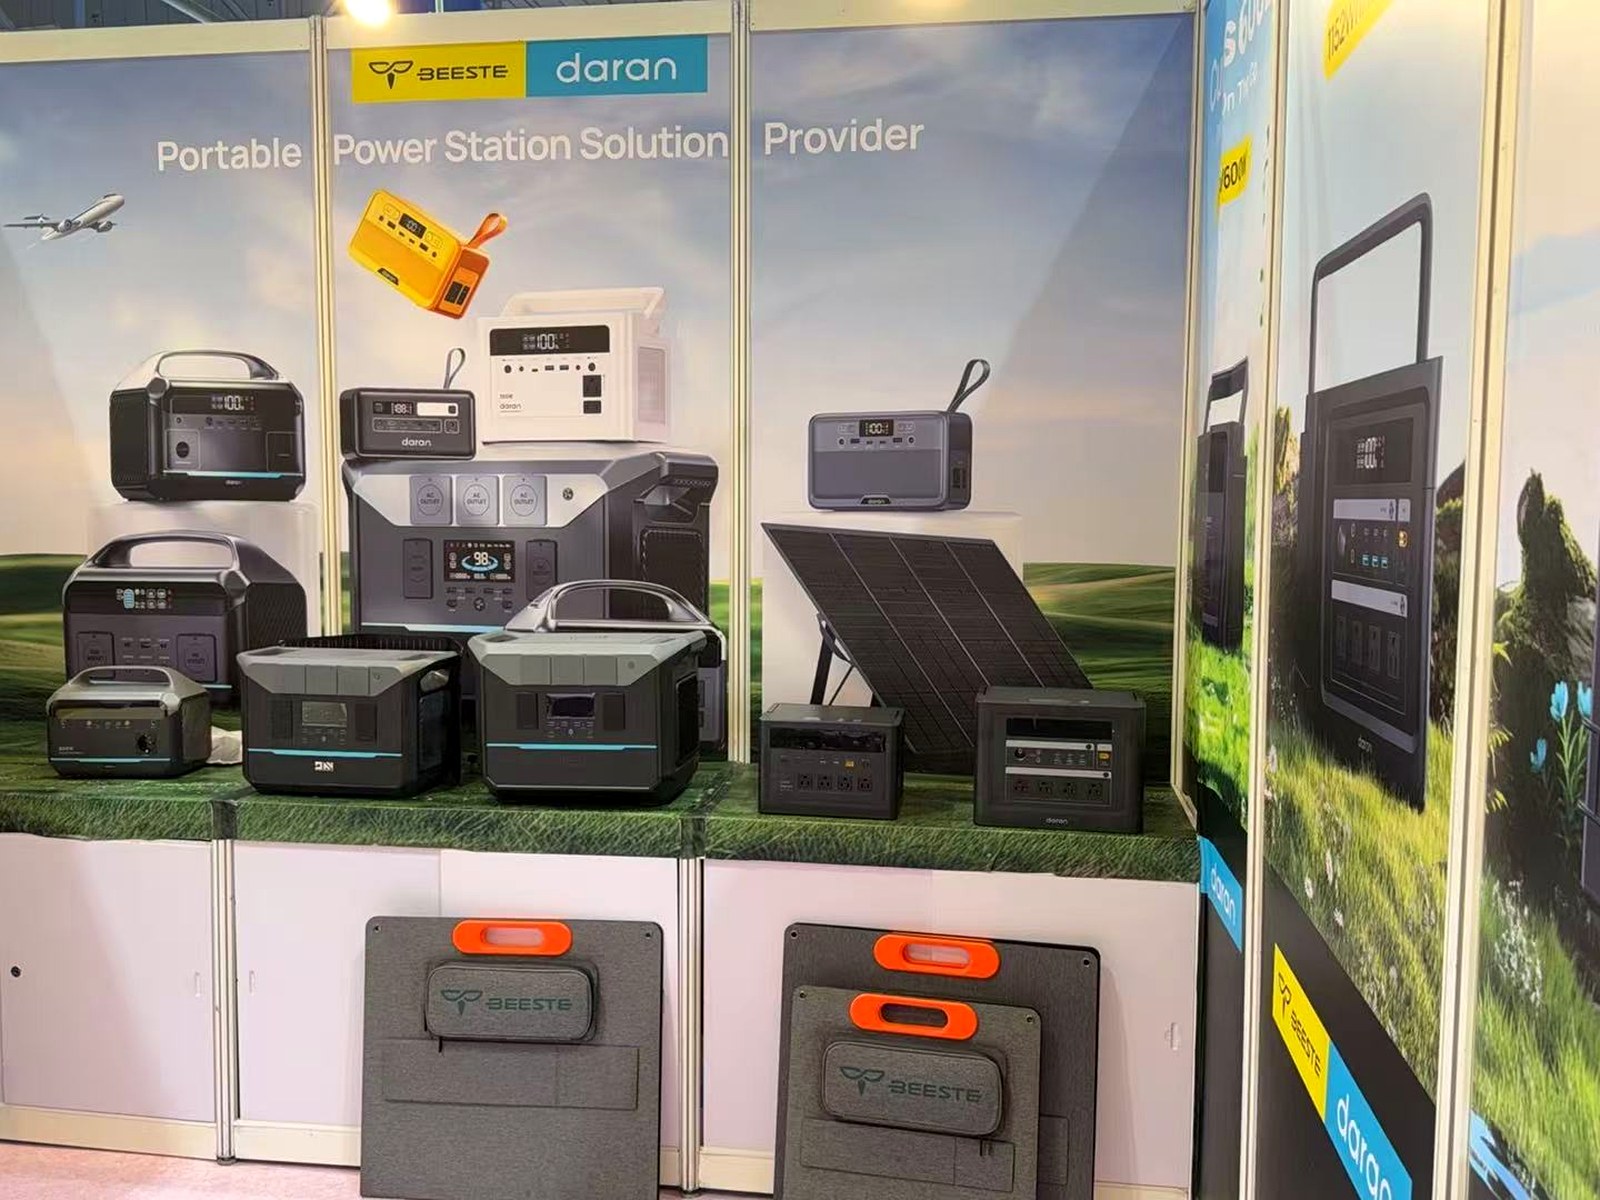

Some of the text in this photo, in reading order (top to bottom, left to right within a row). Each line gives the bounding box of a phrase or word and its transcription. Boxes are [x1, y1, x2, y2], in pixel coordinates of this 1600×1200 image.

[417, 65, 509, 81] BEESTE
[556, 52, 677, 84] daran
[157, 118, 925, 171] Portable Power Station Solution Provider
[401, 437, 432, 447] daran
[1210, 862, 1236, 926] daran
[485, 998, 573, 1011] BEESTE
[1290, 1010, 1321, 1078] BEESTE
[888, 1080, 983, 1104] BEESTE
